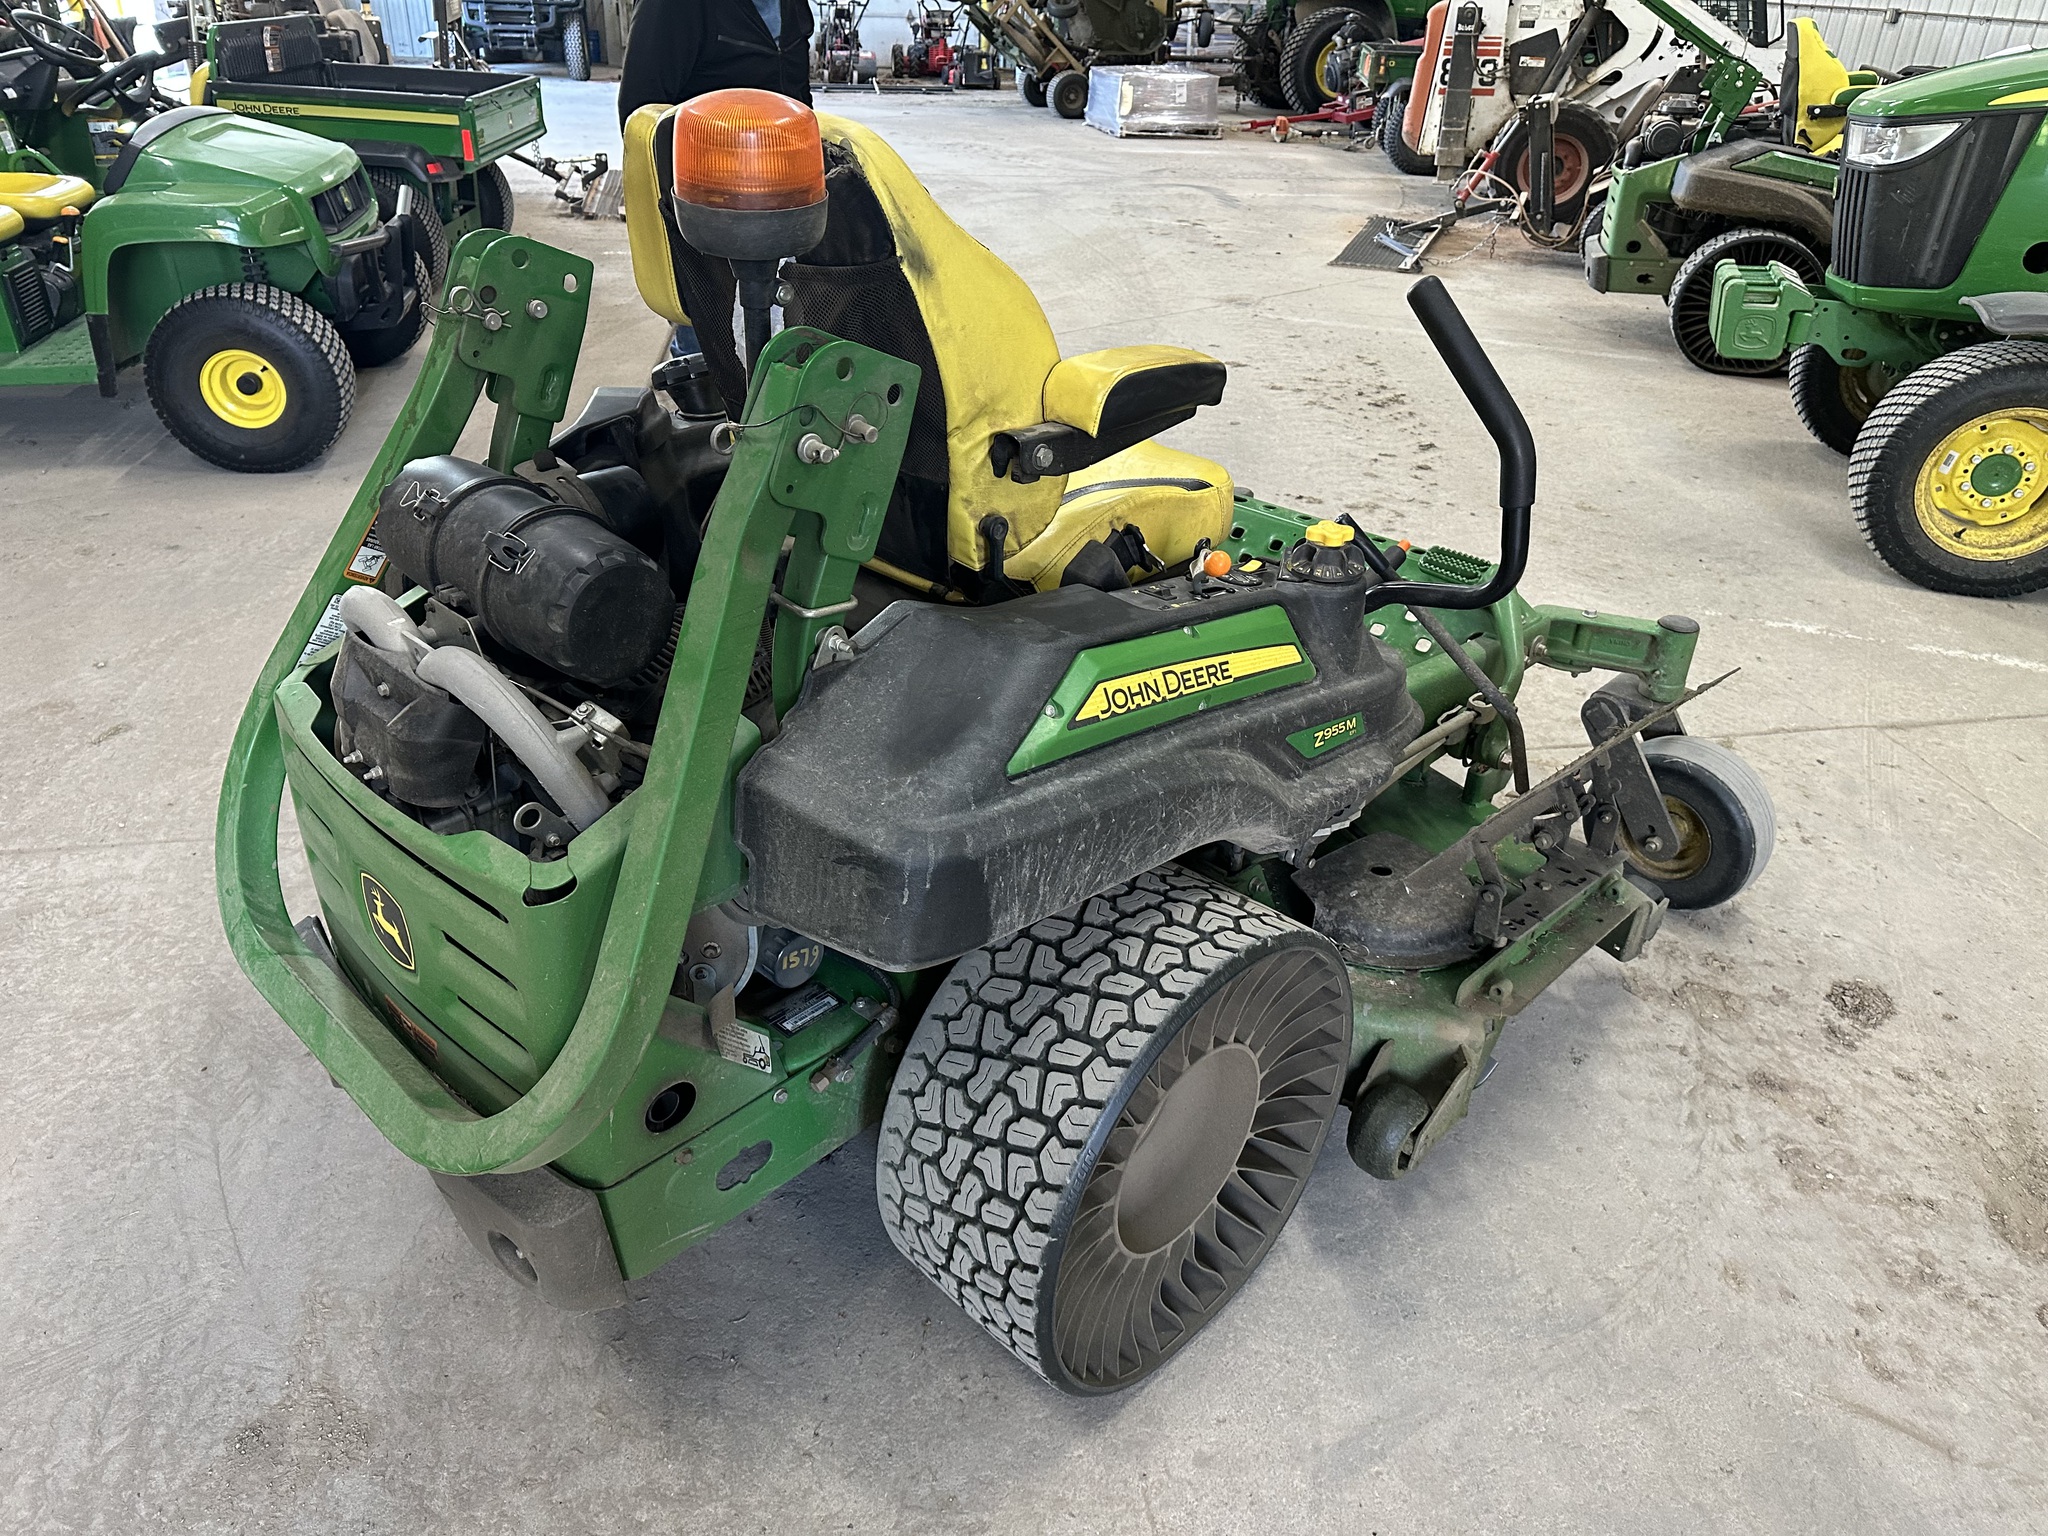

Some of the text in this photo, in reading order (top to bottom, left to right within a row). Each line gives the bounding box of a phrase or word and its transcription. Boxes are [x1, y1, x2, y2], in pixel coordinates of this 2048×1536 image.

[1440, 58, 1498, 86] 83
[232, 102, 300, 115] JOHN DEERE
[1100, 660, 1233, 715] JOHN DEERE
[1314, 716, 1357, 748] Z955M
[782, 944, 820, 970] 1579
